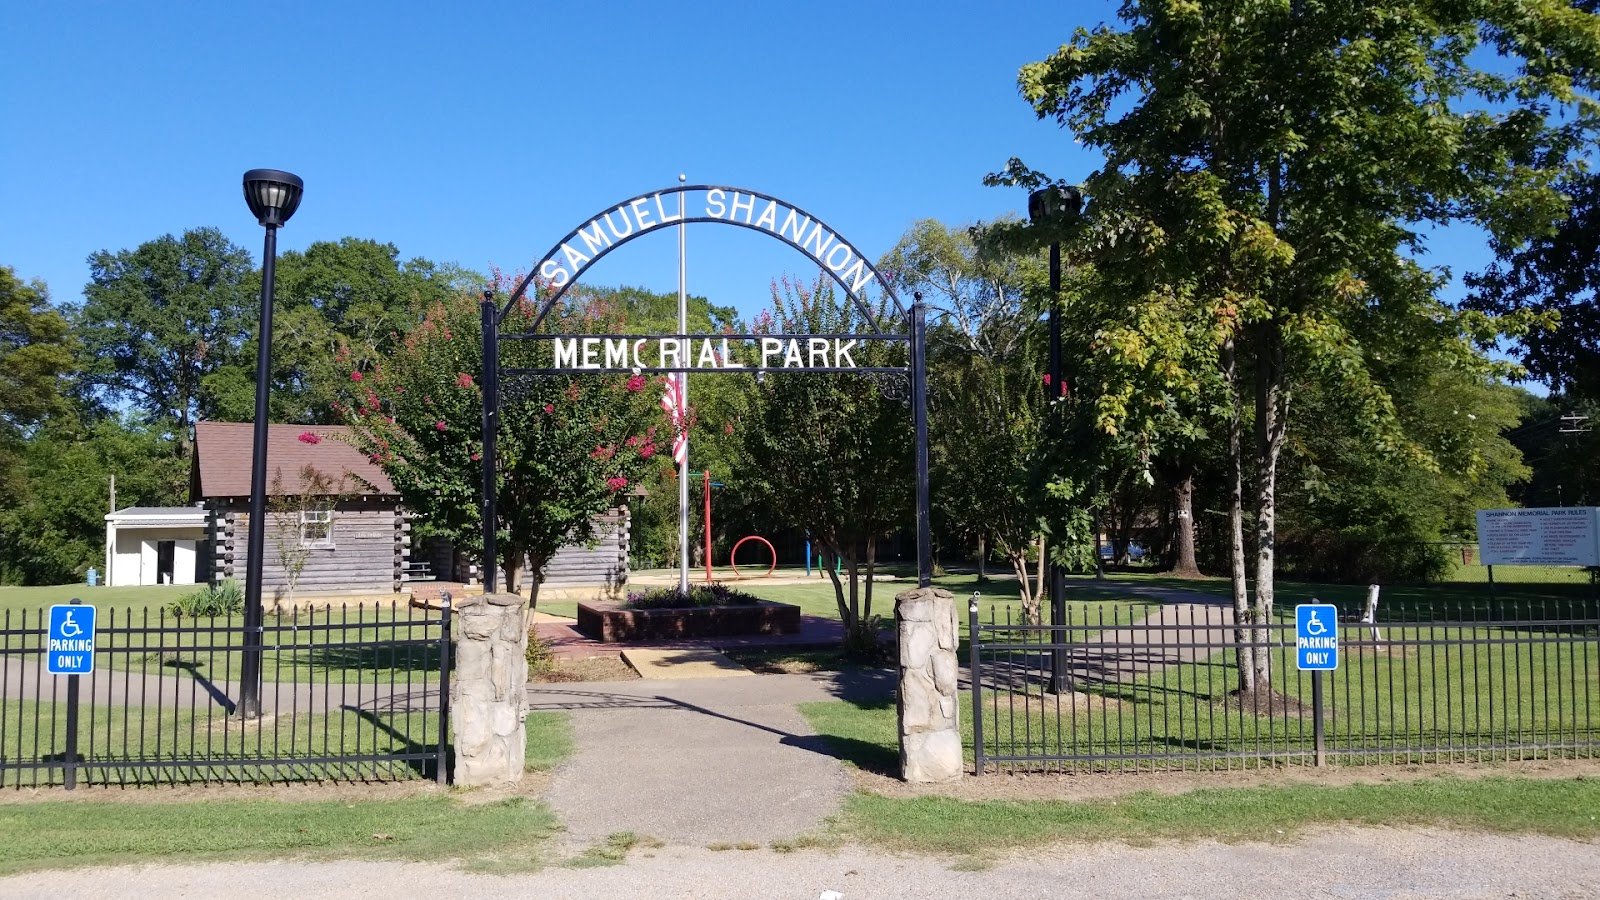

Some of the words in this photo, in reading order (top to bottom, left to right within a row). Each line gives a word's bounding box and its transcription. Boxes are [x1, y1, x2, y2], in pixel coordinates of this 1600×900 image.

[540, 193, 682, 289] SAMUEL
[705, 188, 875, 294] SHANNON
[761, 338, 857, 368] PARK
[50, 639, 92, 652] PARKING
[1299, 637, 1336, 649] PARKING
[58, 655, 83, 668] ONLY
[1306, 652, 1329, 665] ONLY
